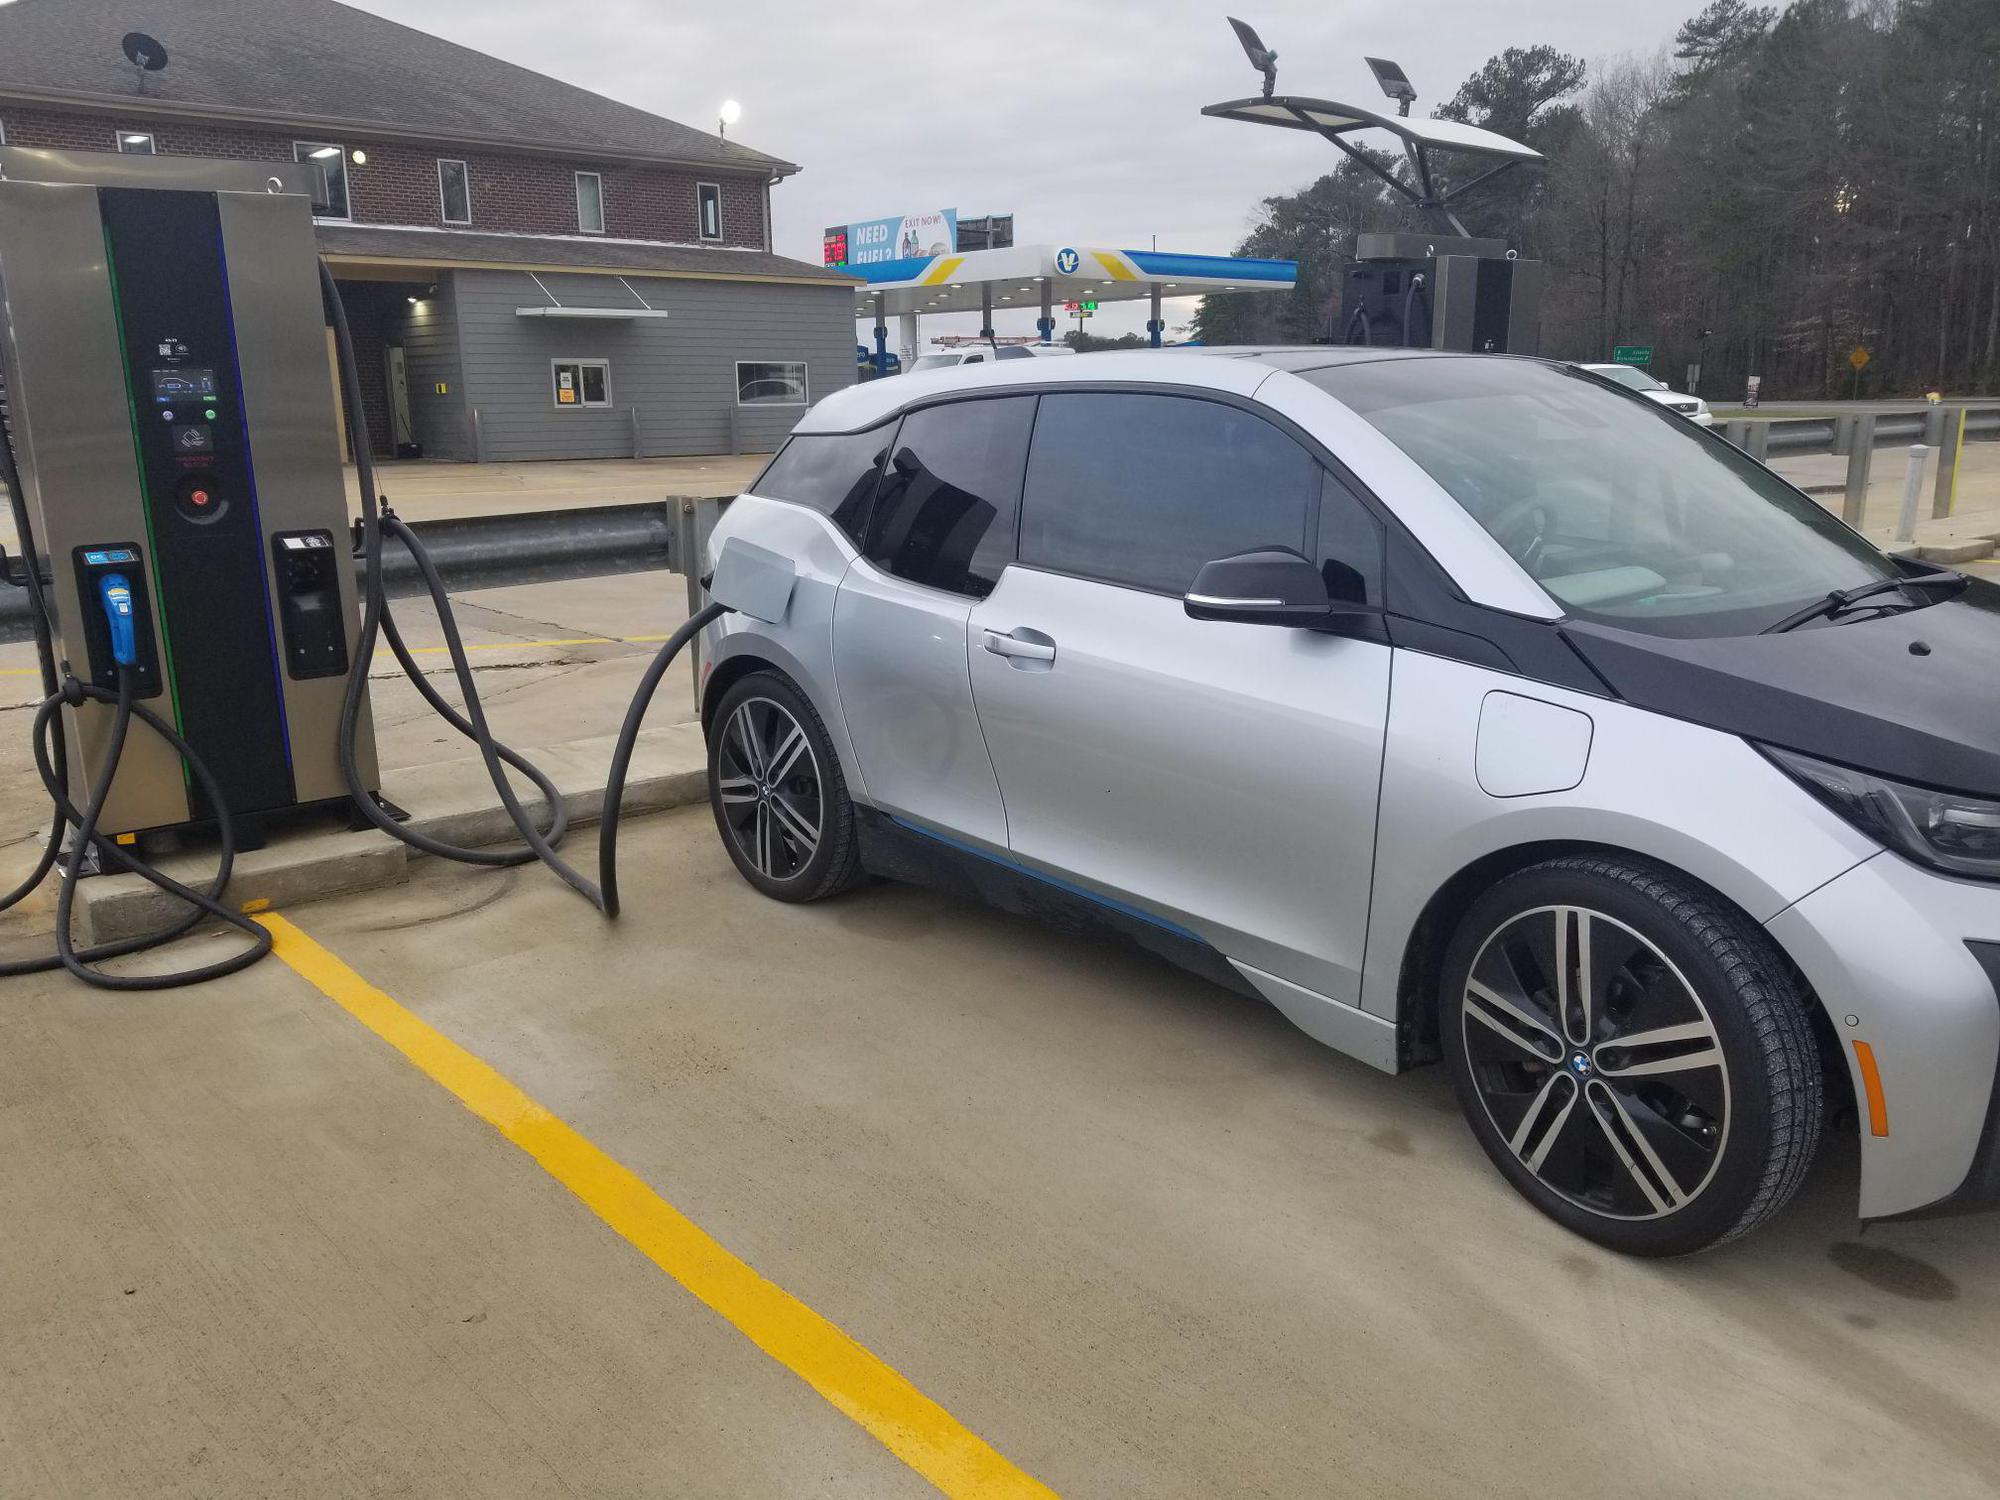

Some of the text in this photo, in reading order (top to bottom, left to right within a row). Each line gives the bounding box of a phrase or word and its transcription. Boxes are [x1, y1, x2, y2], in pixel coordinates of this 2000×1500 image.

[905, 214, 942, 229] EXIT NOW!
[856, 224, 888, 245] NEED
